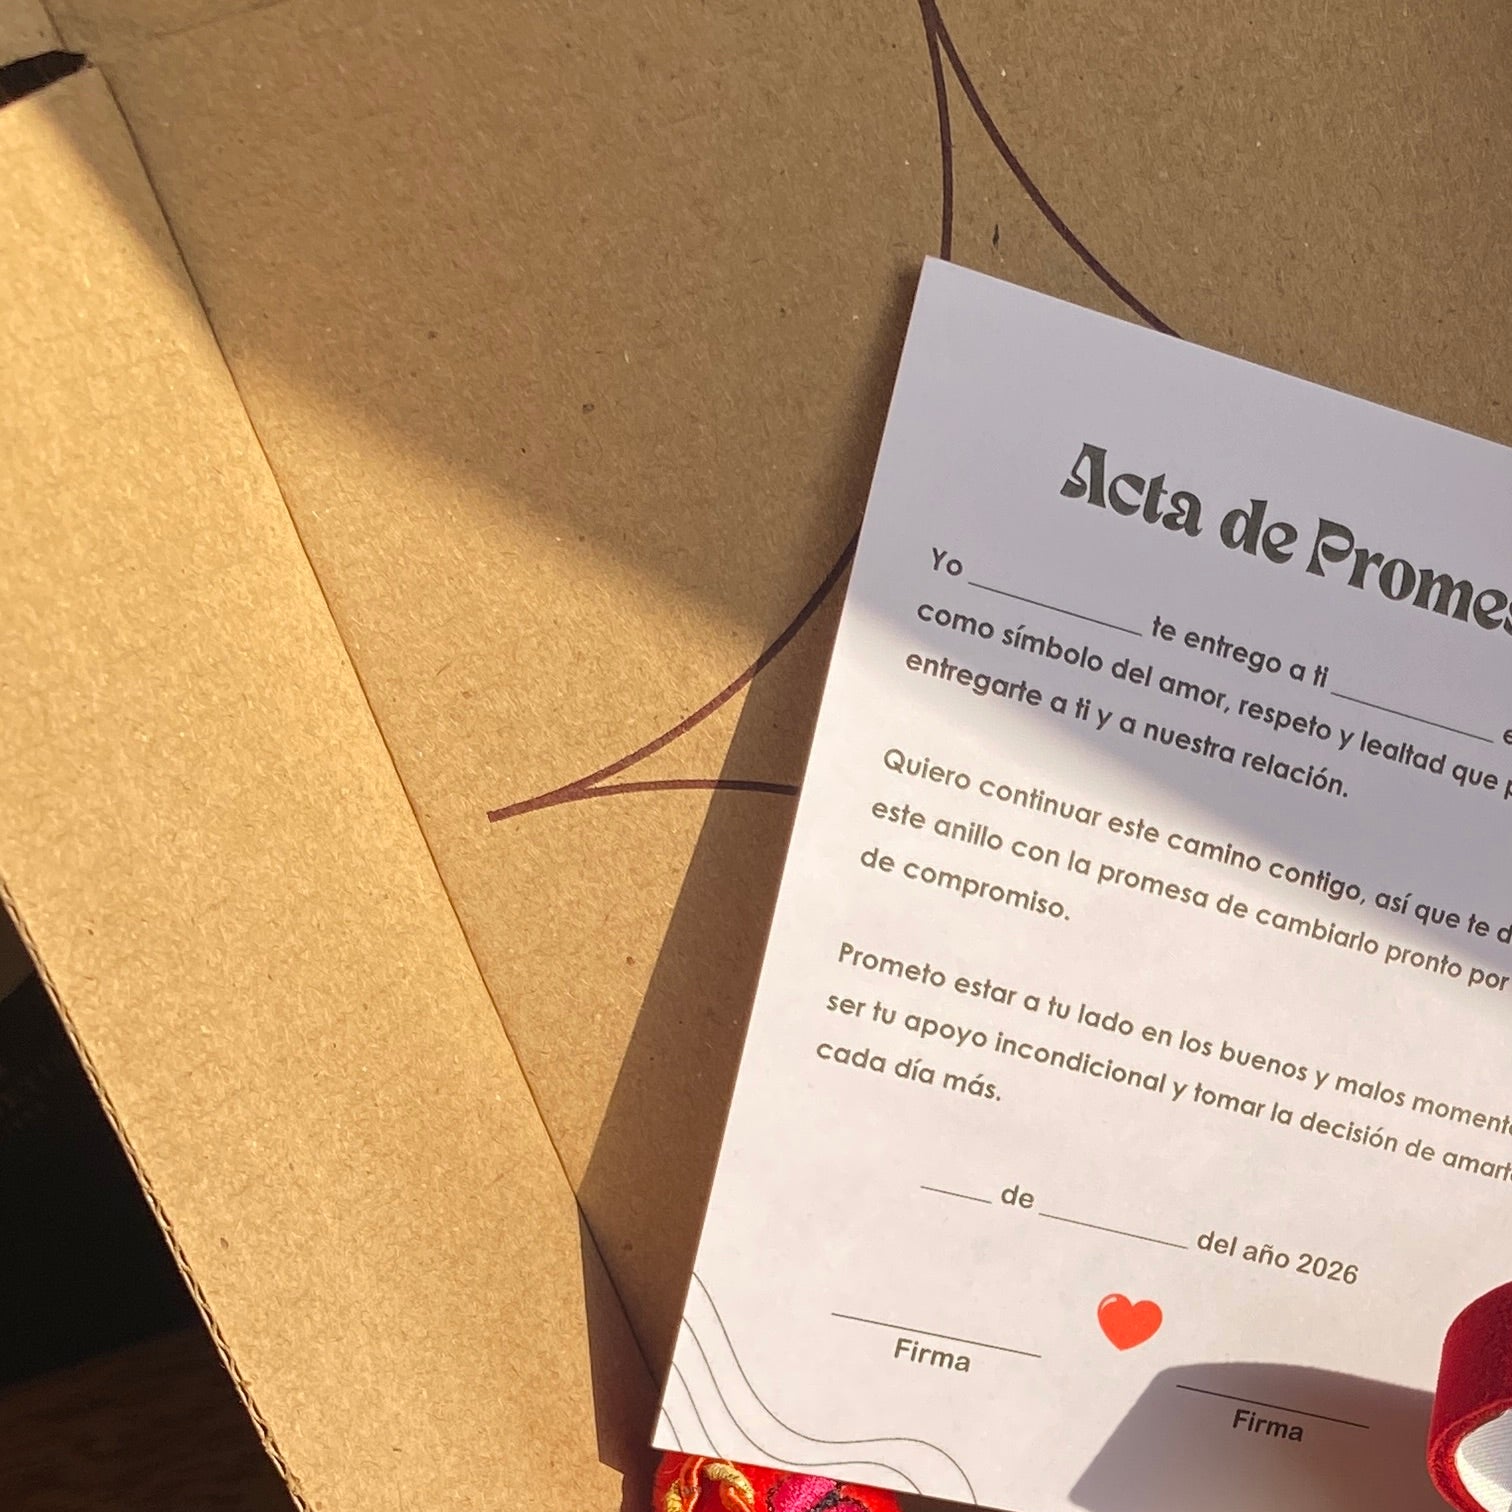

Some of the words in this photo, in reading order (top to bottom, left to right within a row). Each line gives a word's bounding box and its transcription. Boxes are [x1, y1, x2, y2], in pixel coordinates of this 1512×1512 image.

[1060, 442, 1203, 537] Acta
[1220, 499, 1298, 564] de
[932, 547, 963, 576] Yo
[1152, 616, 1176, 641] te
[1184, 632, 1281, 673] entrego
[1290, 664, 1306, 682] a
[1313, 665, 1329, 688] ti
[906, 654, 1042, 706] entregarte
[1050, 696, 1067, 714] a
[1075, 697, 1091, 720] ti
[1096, 708, 1113, 730] y
[1120, 717, 1136, 734] a
[1144, 723, 1235, 763] nuestra
[1242, 752, 1347, 797] relación.
[918, 604, 994, 639] como
[1002, 624, 1103, 671] símbolo
[1112, 658, 1153, 687] del
[1159, 676, 1230, 714] amor,
[1238, 699, 1331, 740] respeto
[1338, 729, 1355, 750] y
[1360, 730, 1447, 774] lealtad
[1452, 764, 1498, 790] que
[861, 847, 895, 872] de
[904, 862, 1070, 921] compromiso.
[872, 802, 926, 829] este
[934, 819, 1003, 850] anillo
[1011, 841, 1060, 867] con
[1067, 850, 1091, 875] la
[1097, 864, 1209, 908] promesa
[1216, 894, 1248, 918] de
[1256, 909, 1379, 954] cambiarlo
[1384, 945, 1462, 978] pronto
[1468, 968, 1510, 991] por
[884, 749, 971, 790] Quiero
[979, 780, 1102, 826] continuar
[1108, 817, 1159, 843] este
[1168, 834, 1261, 872] camino
[1269, 863, 1365, 905] contigo,
[1375, 893, 1412, 914] así
[1415, 904, 1460, 928] que
[1467, 914, 1489, 936] te
[816, 1043, 887, 1073] cada
[895, 1058, 935, 1085] día
[943, 1073, 1000, 1101] más.
[826, 995, 866, 1017] ser
[873, 1001, 897, 1025] tu
[905, 1015, 987, 1047] apoyo
[995, 1031, 1166, 1093] incondicional
[1171, 1081, 1188, 1102] y
[1193, 1082, 1266, 1118] tomar
[1271, 1101, 1293, 1126] la
[1300, 1112, 1398, 1152] decisión
[1405, 1139, 1435, 1161] de
[838, 942, 946, 987] Prometo
[954, 977, 1018, 1005] estar
[1024, 995, 1040, 1012] a
[1048, 996, 1071, 1019] tu
[1078, 1003, 1134, 1035] lado
[1142, 1026, 1173, 1047] en
[1179, 1030, 1213, 1057] los
[1220, 1040, 1308, 1081] buenos
[1314, 1070, 1330, 1090] y
[1335, 1076, 1406, 1107] malos
[1001, 1185, 1034, 1208] de
[1197, 1231, 1238, 1256] del
[1242, 1244, 1289, 1268] año
[1296, 1253, 1358, 1284] 2026
[894, 1338, 970, 1372] Firma
[1233, 1409, 1303, 1442] Firma
